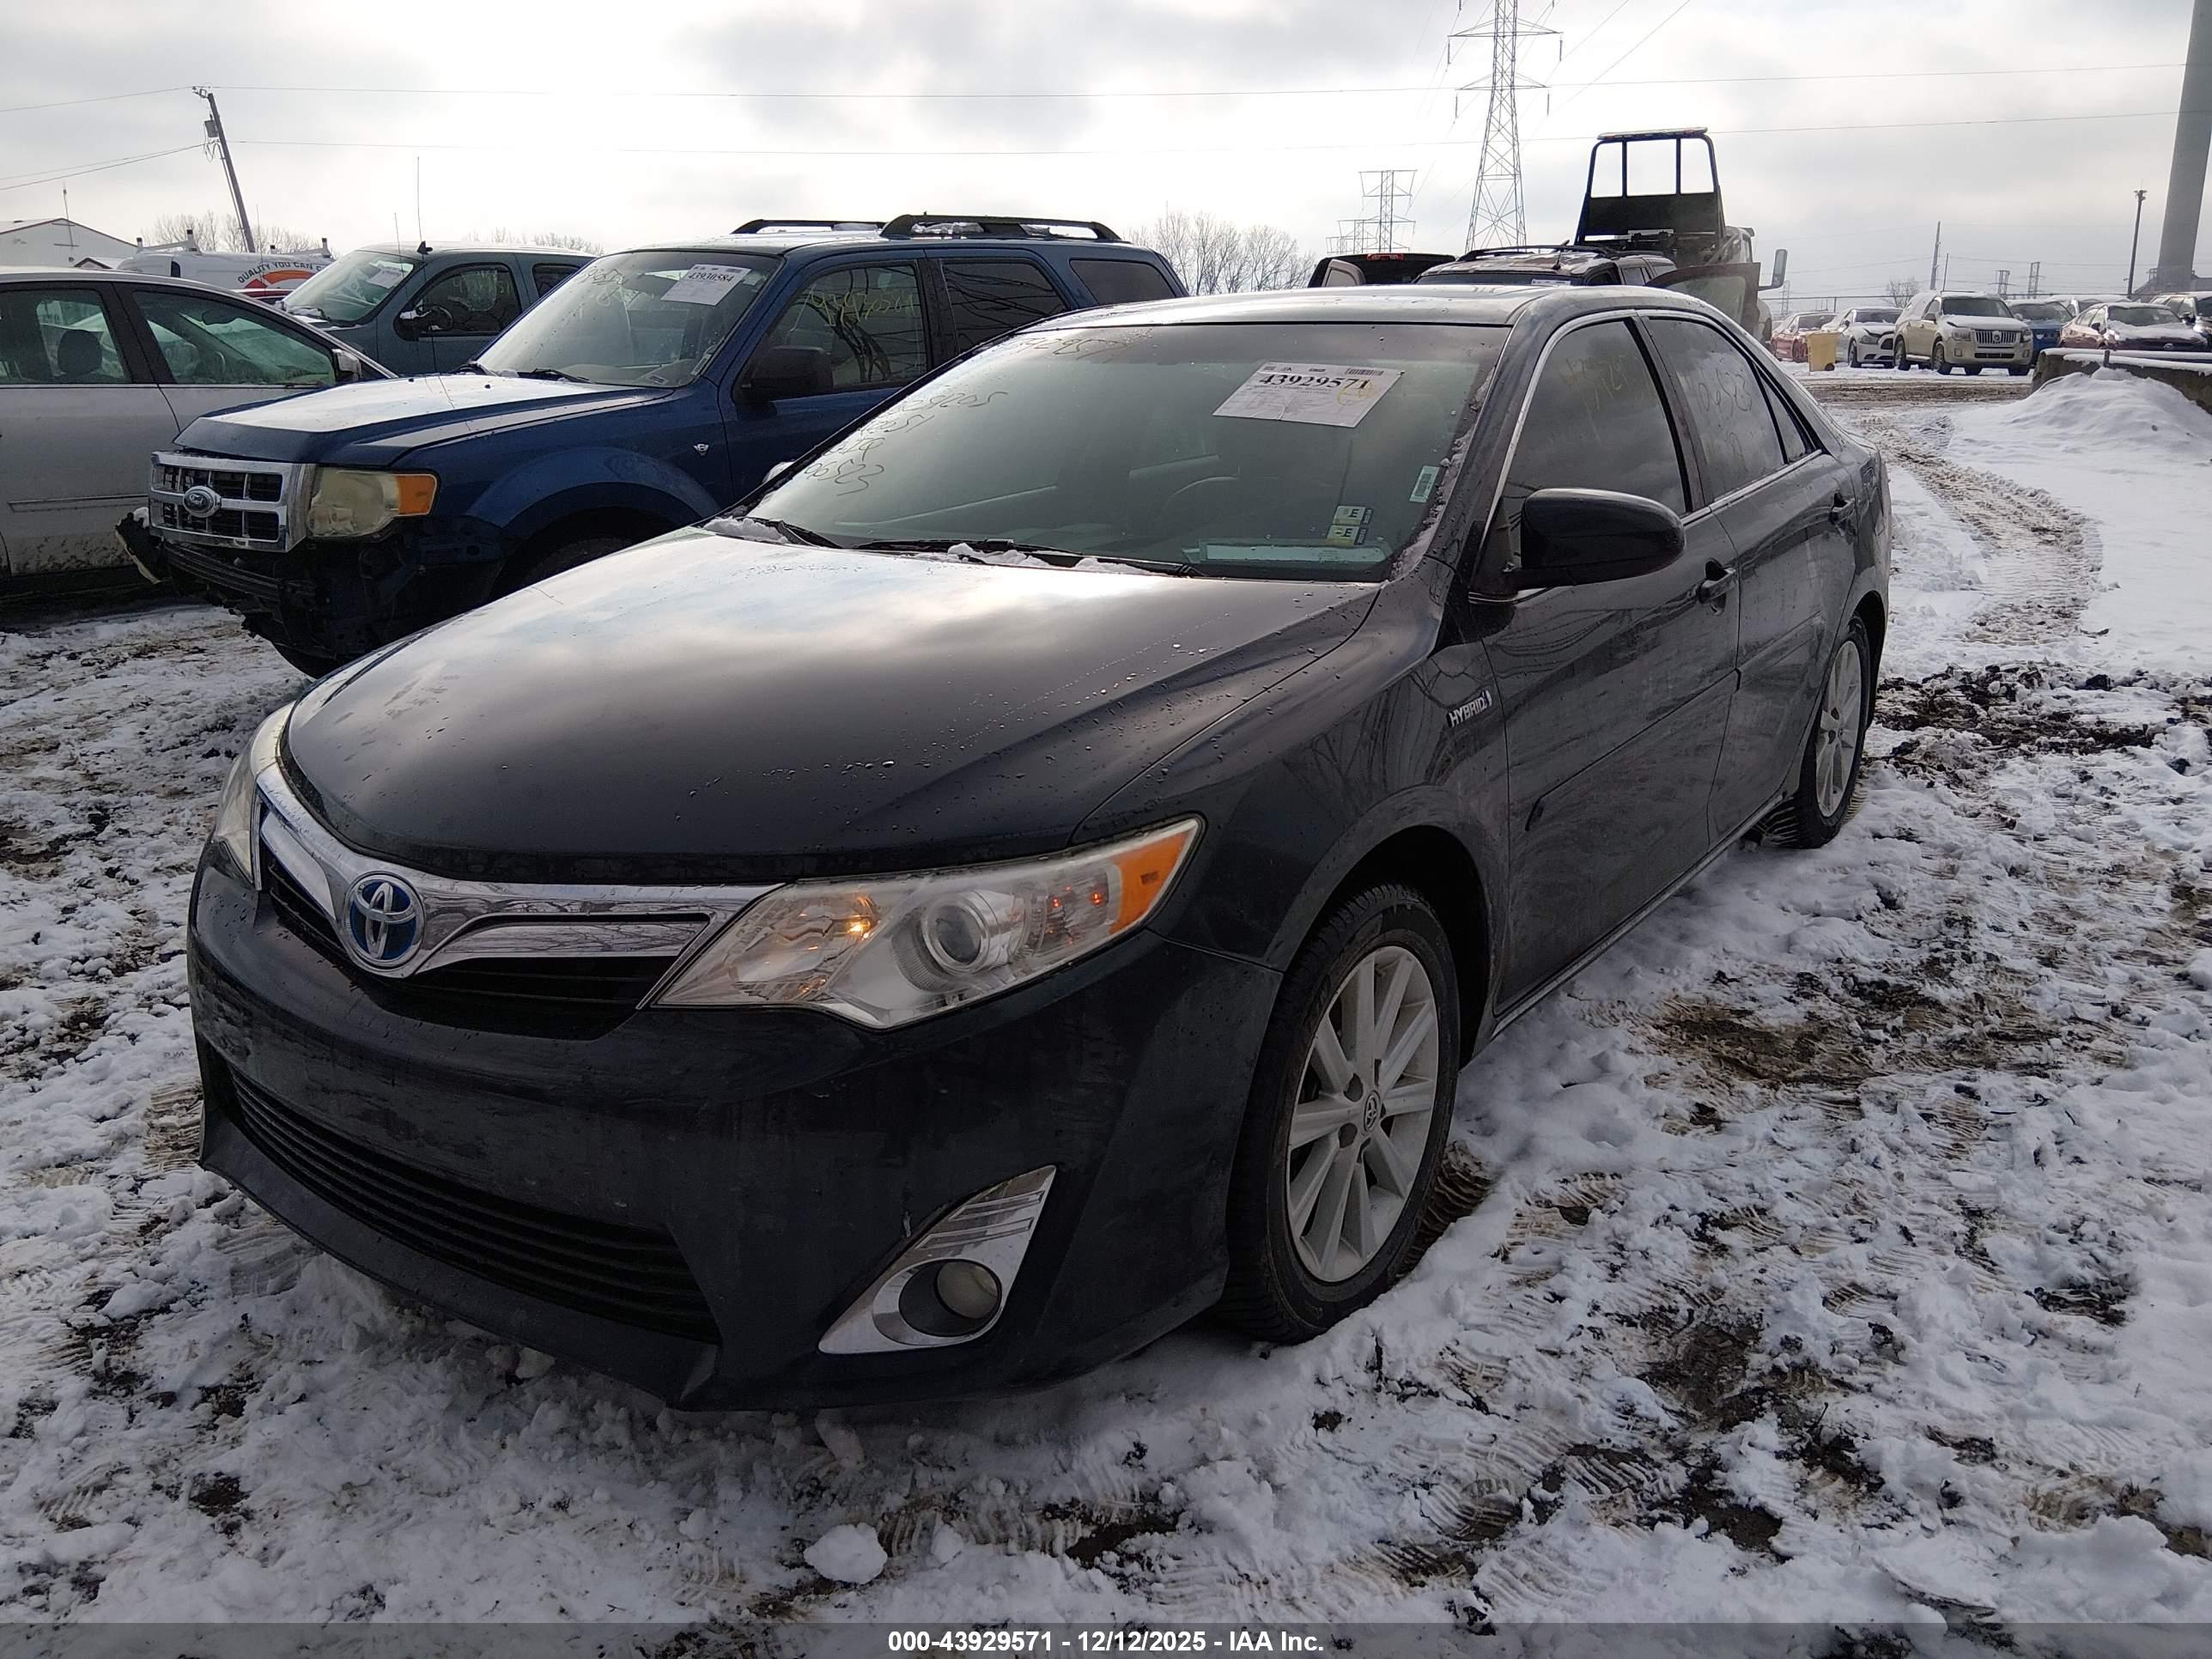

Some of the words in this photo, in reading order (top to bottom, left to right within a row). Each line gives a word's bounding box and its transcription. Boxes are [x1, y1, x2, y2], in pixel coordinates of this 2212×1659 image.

[237, 264, 271, 283] QUALITY
[293, 261, 313, 270] CAN
[688, 271, 735, 283] 43930584
[1258, 373, 1370, 390] 43929571
[1447, 696, 1487, 728] HYBRID
